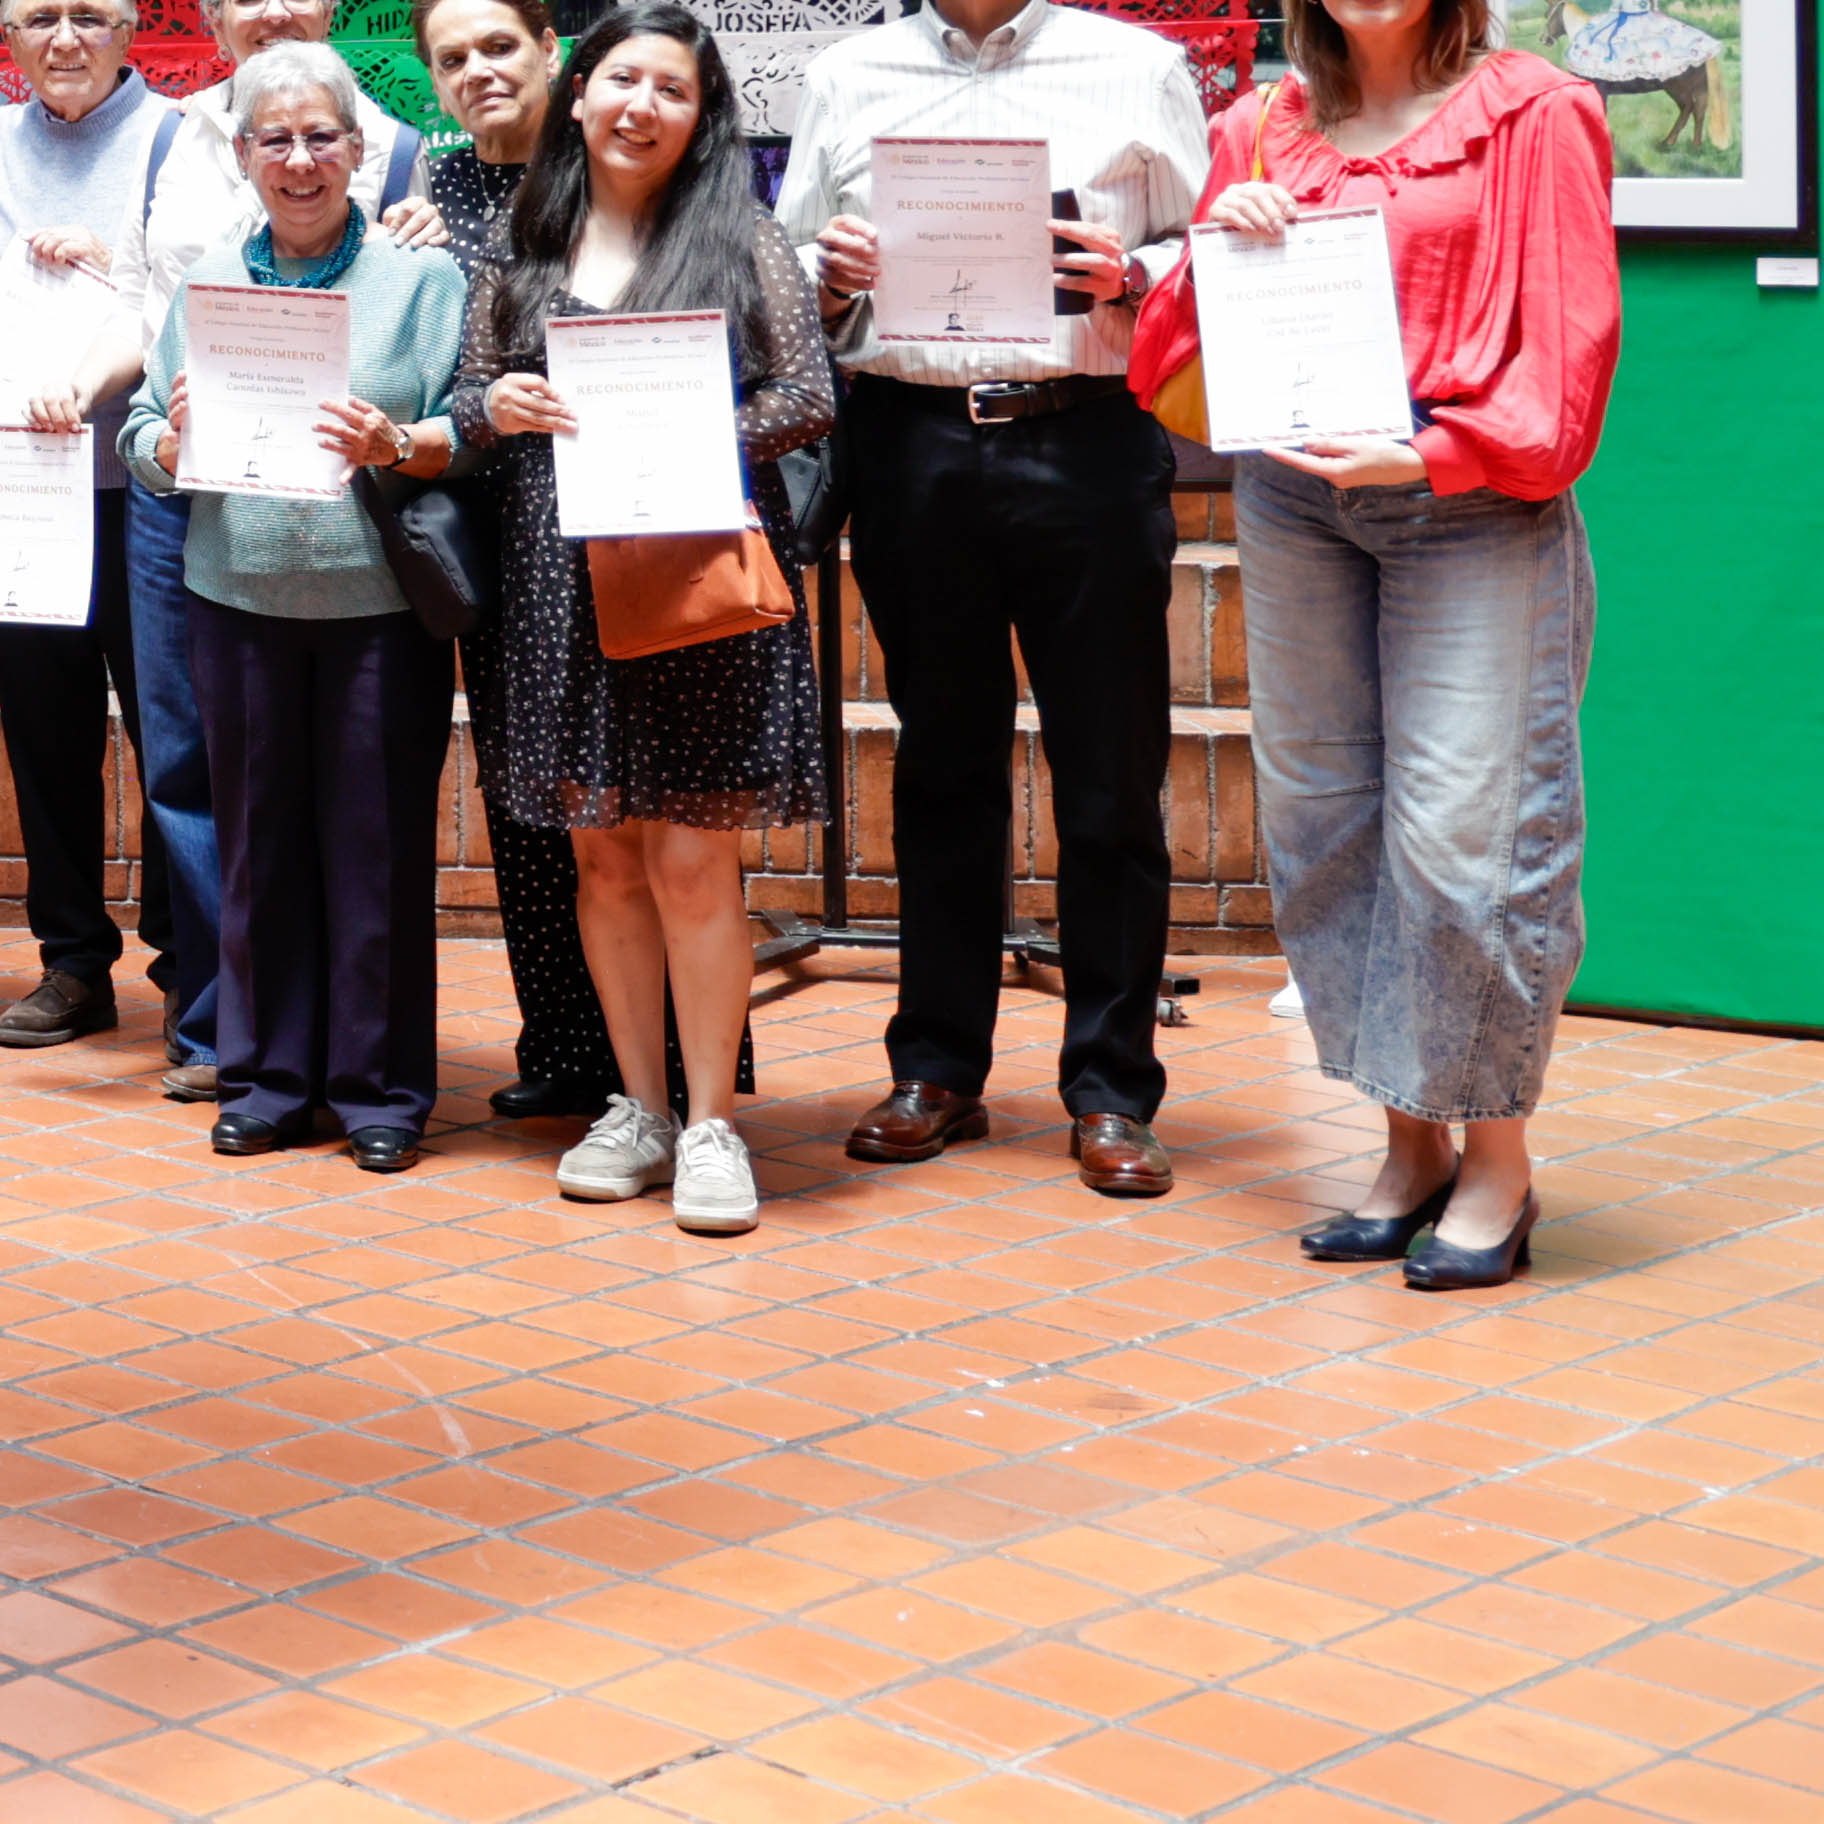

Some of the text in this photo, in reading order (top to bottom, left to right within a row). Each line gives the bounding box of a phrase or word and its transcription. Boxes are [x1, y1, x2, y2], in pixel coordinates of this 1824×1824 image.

[713, 11, 813, 33] JOSEFA
[896, 199, 1025, 212] RECONOCIMIENTO
[916, 231, 950, 243] Miguel
[952, 231, 993, 241] Victoria
[209, 343, 327, 362] RECONOCIMIENTO
[576, 379, 704, 396] RECONOCIMIENTO
